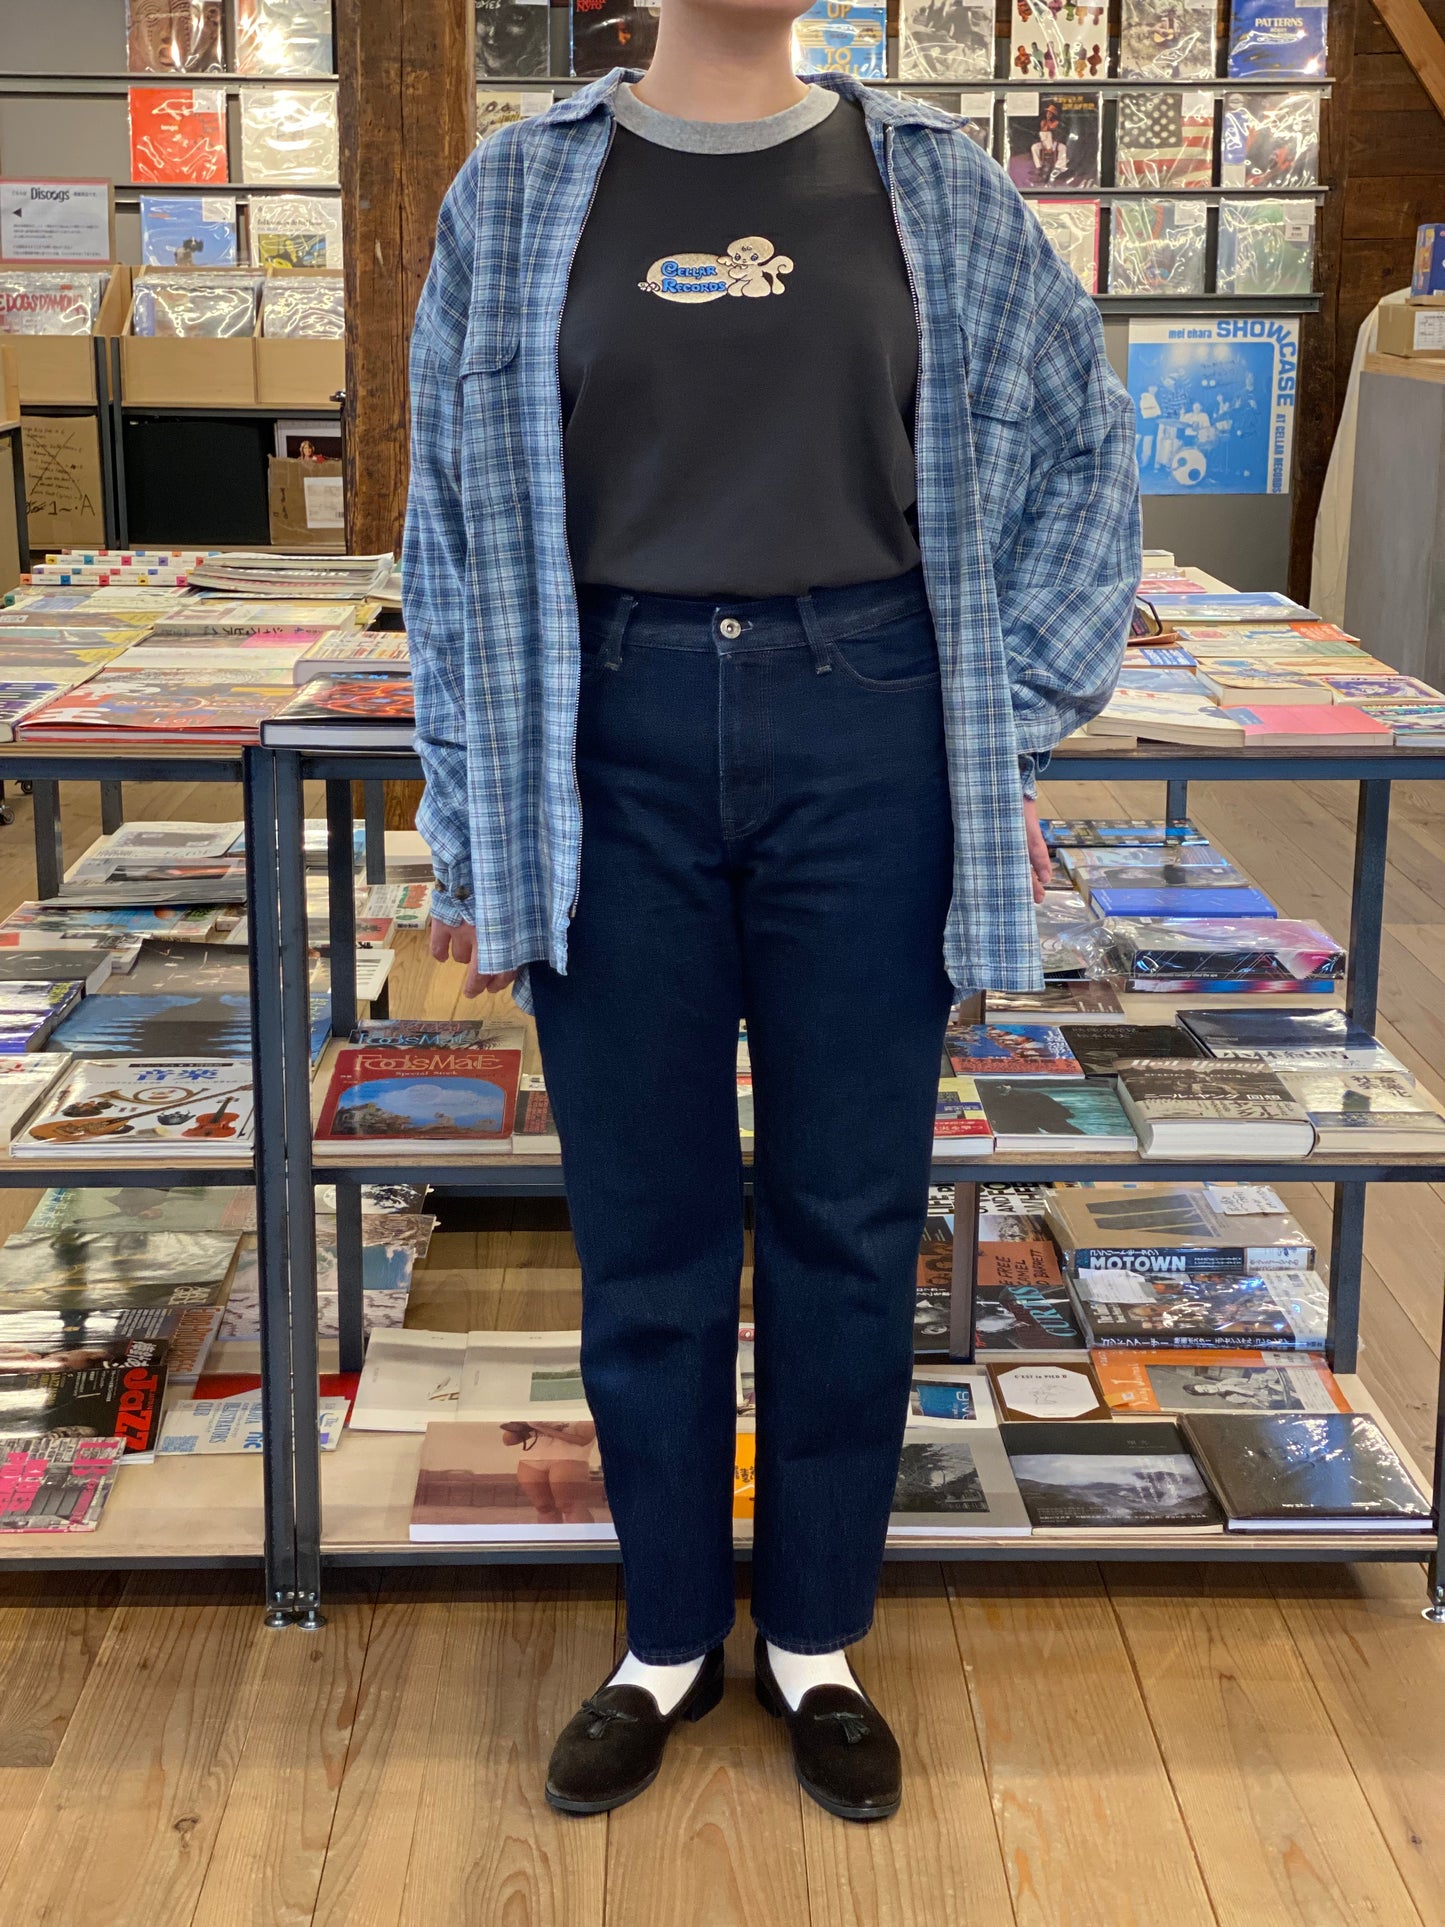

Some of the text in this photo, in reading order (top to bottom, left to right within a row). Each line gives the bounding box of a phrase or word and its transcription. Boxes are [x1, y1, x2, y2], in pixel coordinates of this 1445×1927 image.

[576, 2, 602, 12] Nyro
[827, 1, 851, 19] UP
[1255, 18, 1303, 27] PATTERNS
[825, 48, 851, 64] TO
[30, 187, 70, 202] Discogs
[6, 293, 37, 313] DOGS
[1168, 319, 1298, 494] mei ehara SHOWCASE AT CELLAR RECORDS
[133, 1069, 219, 1081] 音楽
[992, 1196, 1017, 1213] AND
[995, 1255, 1014, 1278] FREE
[1030, 1248, 1050, 1279] BARRETT
[1089, 1255, 1186, 1272] MOTOWN
[1008, 1286, 1078, 1337] CURTIS
[193, 1402, 215, 1417] CLUB
